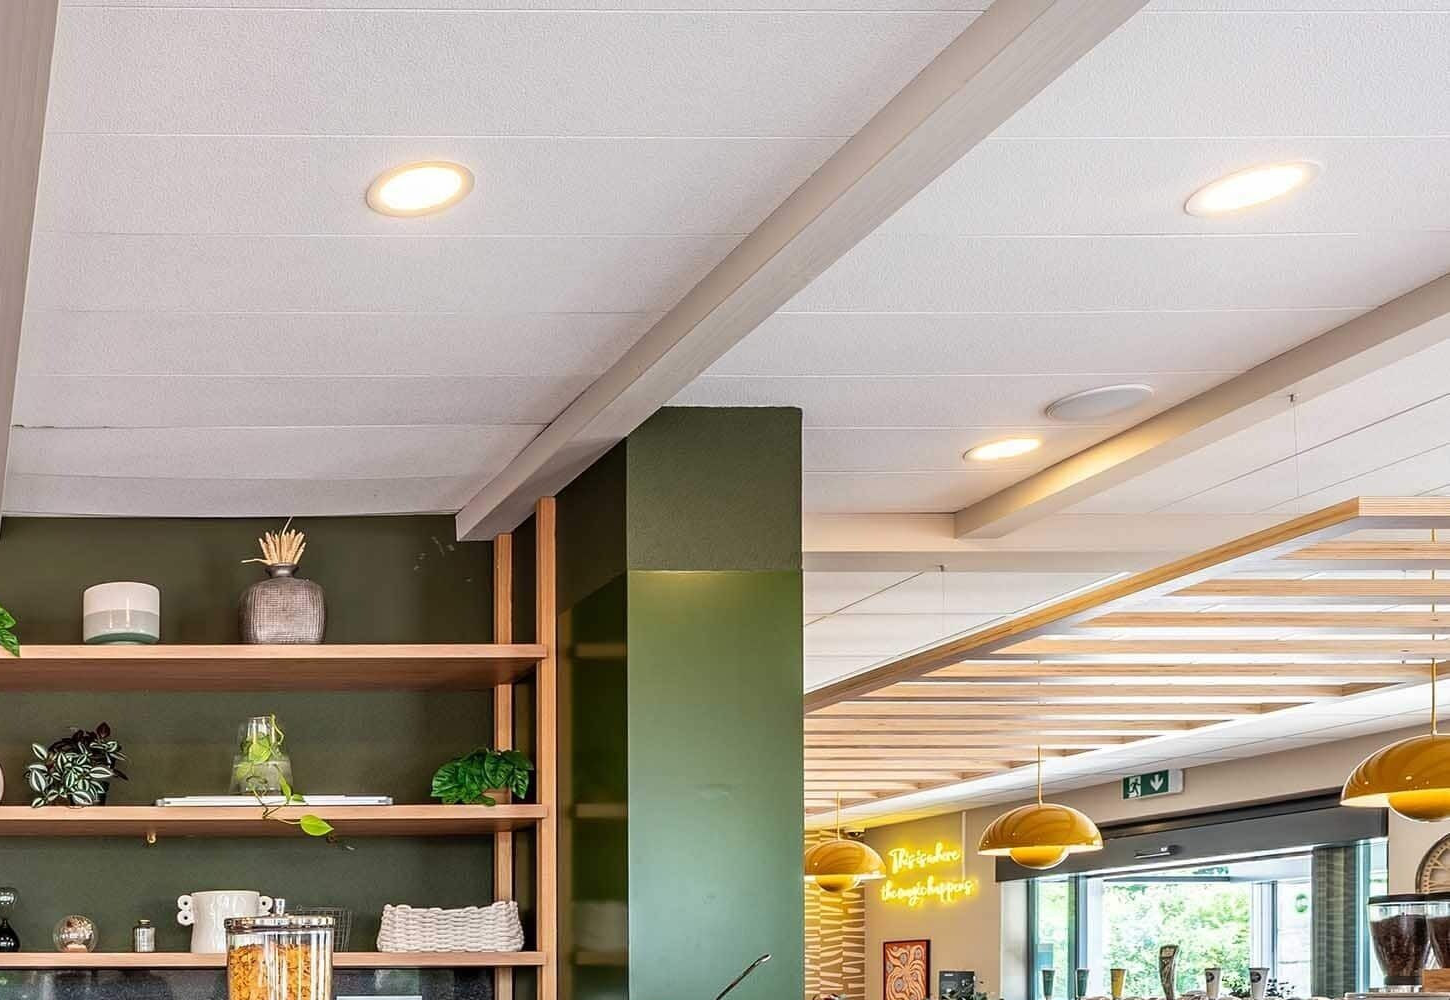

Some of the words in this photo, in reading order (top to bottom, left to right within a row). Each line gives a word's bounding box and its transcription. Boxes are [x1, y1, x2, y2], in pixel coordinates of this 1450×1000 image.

[888, 847, 914, 874] This
[927, 841, 961, 864] where
[881, 880, 896, 901] the
[896, 881, 927, 906] magic
